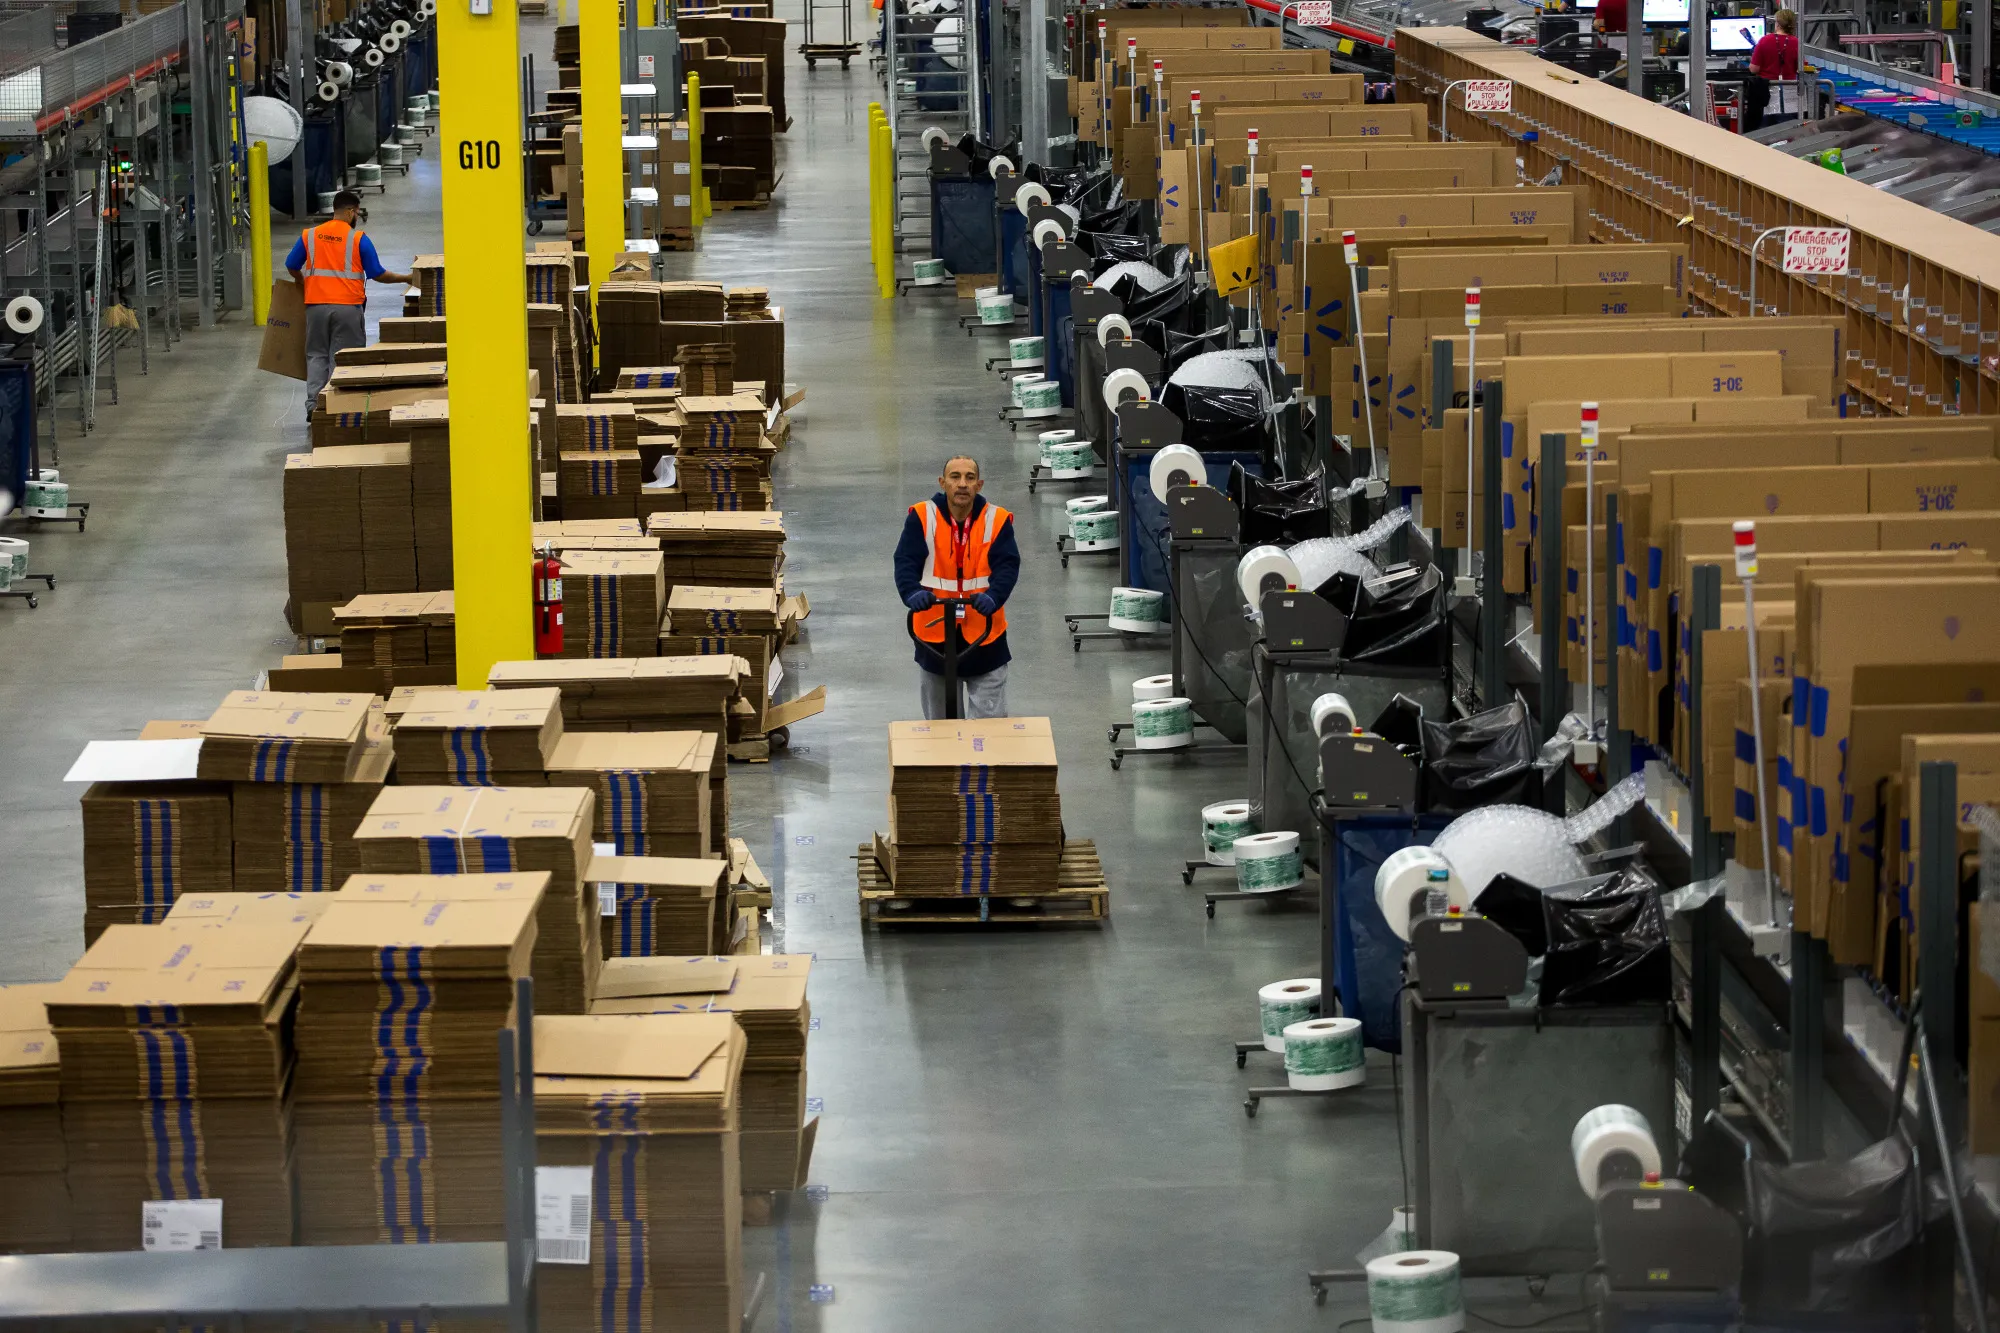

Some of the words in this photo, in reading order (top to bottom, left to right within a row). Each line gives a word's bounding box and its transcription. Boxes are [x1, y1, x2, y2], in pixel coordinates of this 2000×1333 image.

[459, 140, 500, 170] G10
[1793, 234, 1841, 245] EMERGENCY
[1806, 246, 1827, 255] STOP
[1792, 256, 1811, 266] PULL
[1813, 257, 1839, 267] CABLE
[1602, 303, 1628, 314] 30-E
[1713, 377, 1743, 392] 30-E
[1919, 494, 1955, 511] 30-E
